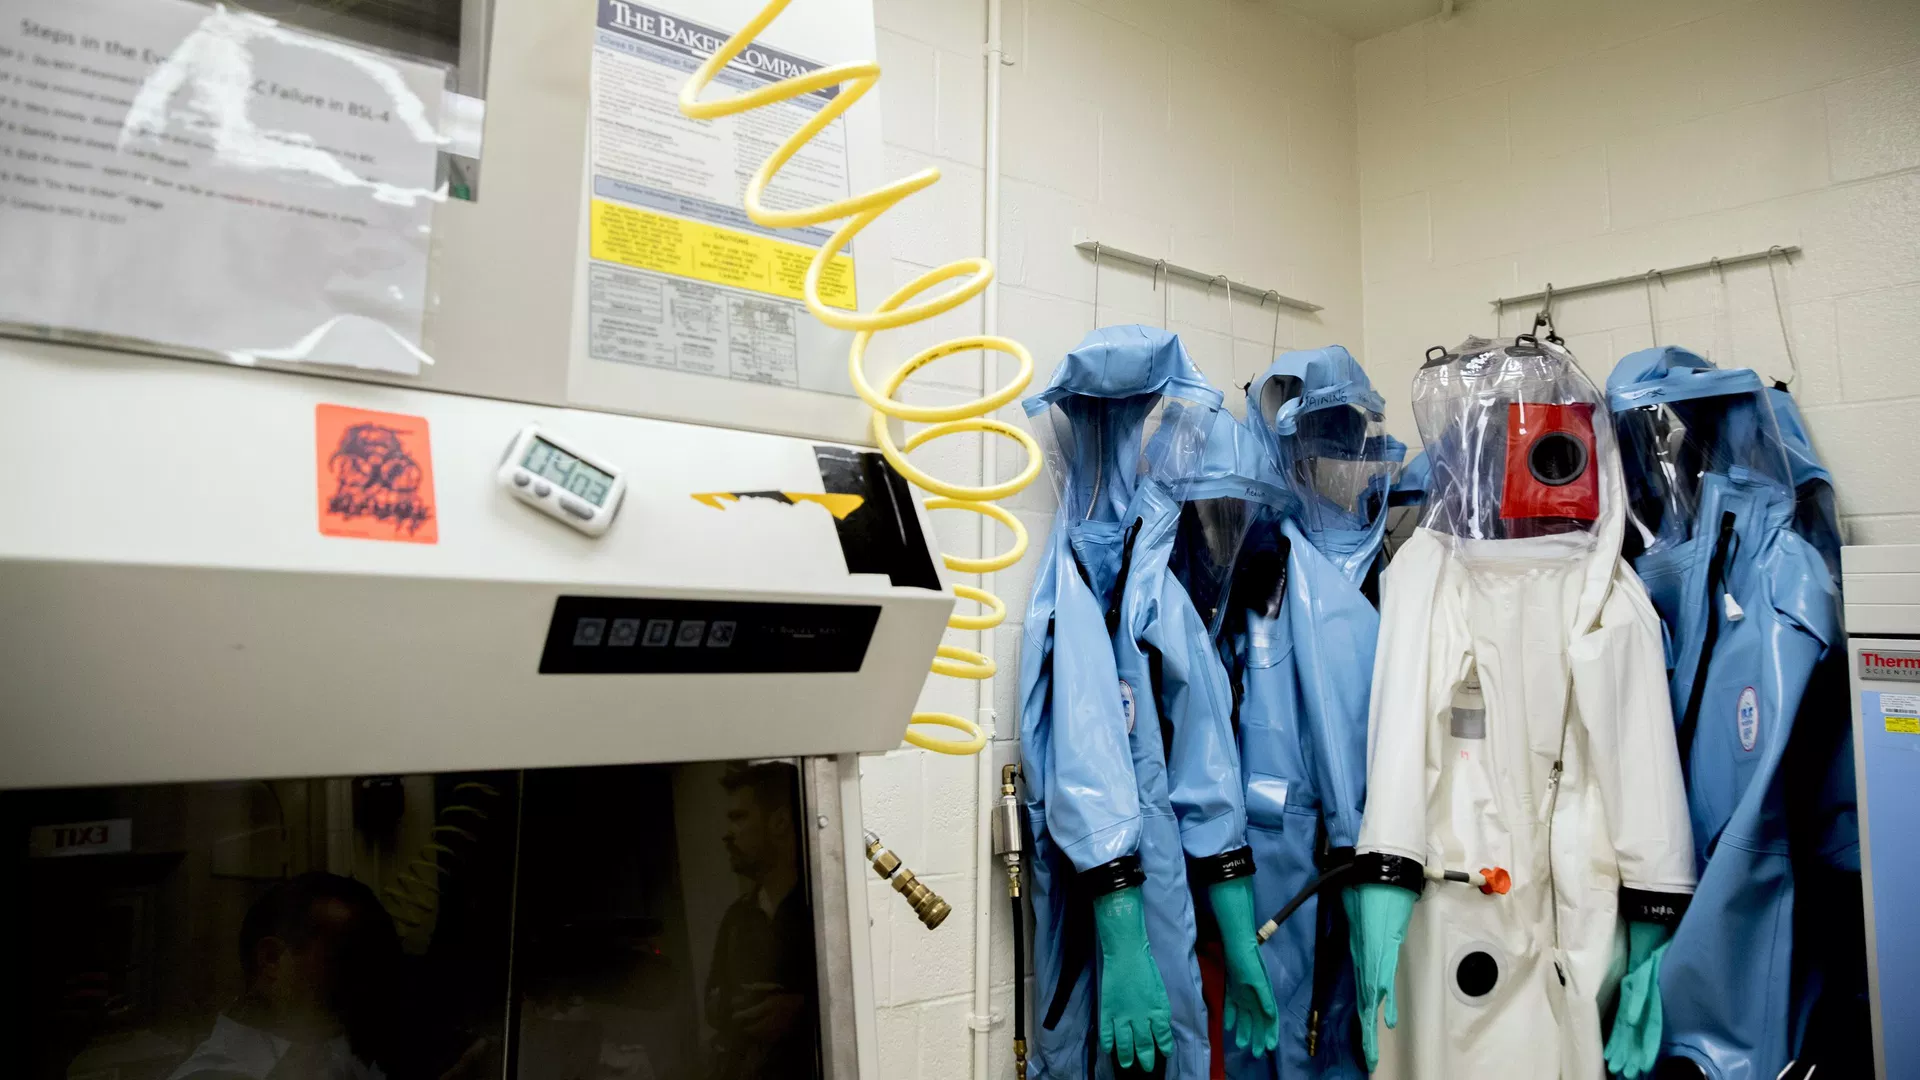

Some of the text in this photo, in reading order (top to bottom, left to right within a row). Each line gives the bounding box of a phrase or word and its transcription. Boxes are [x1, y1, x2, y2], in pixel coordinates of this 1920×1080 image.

[20, 18, 76, 45] Steps
[80, 34, 100, 49] in
[105, 40, 137, 59] the
[270, 81, 325, 108] Failure
[328, 98, 344, 113] in
[348, 101, 390, 123] BSL-4
